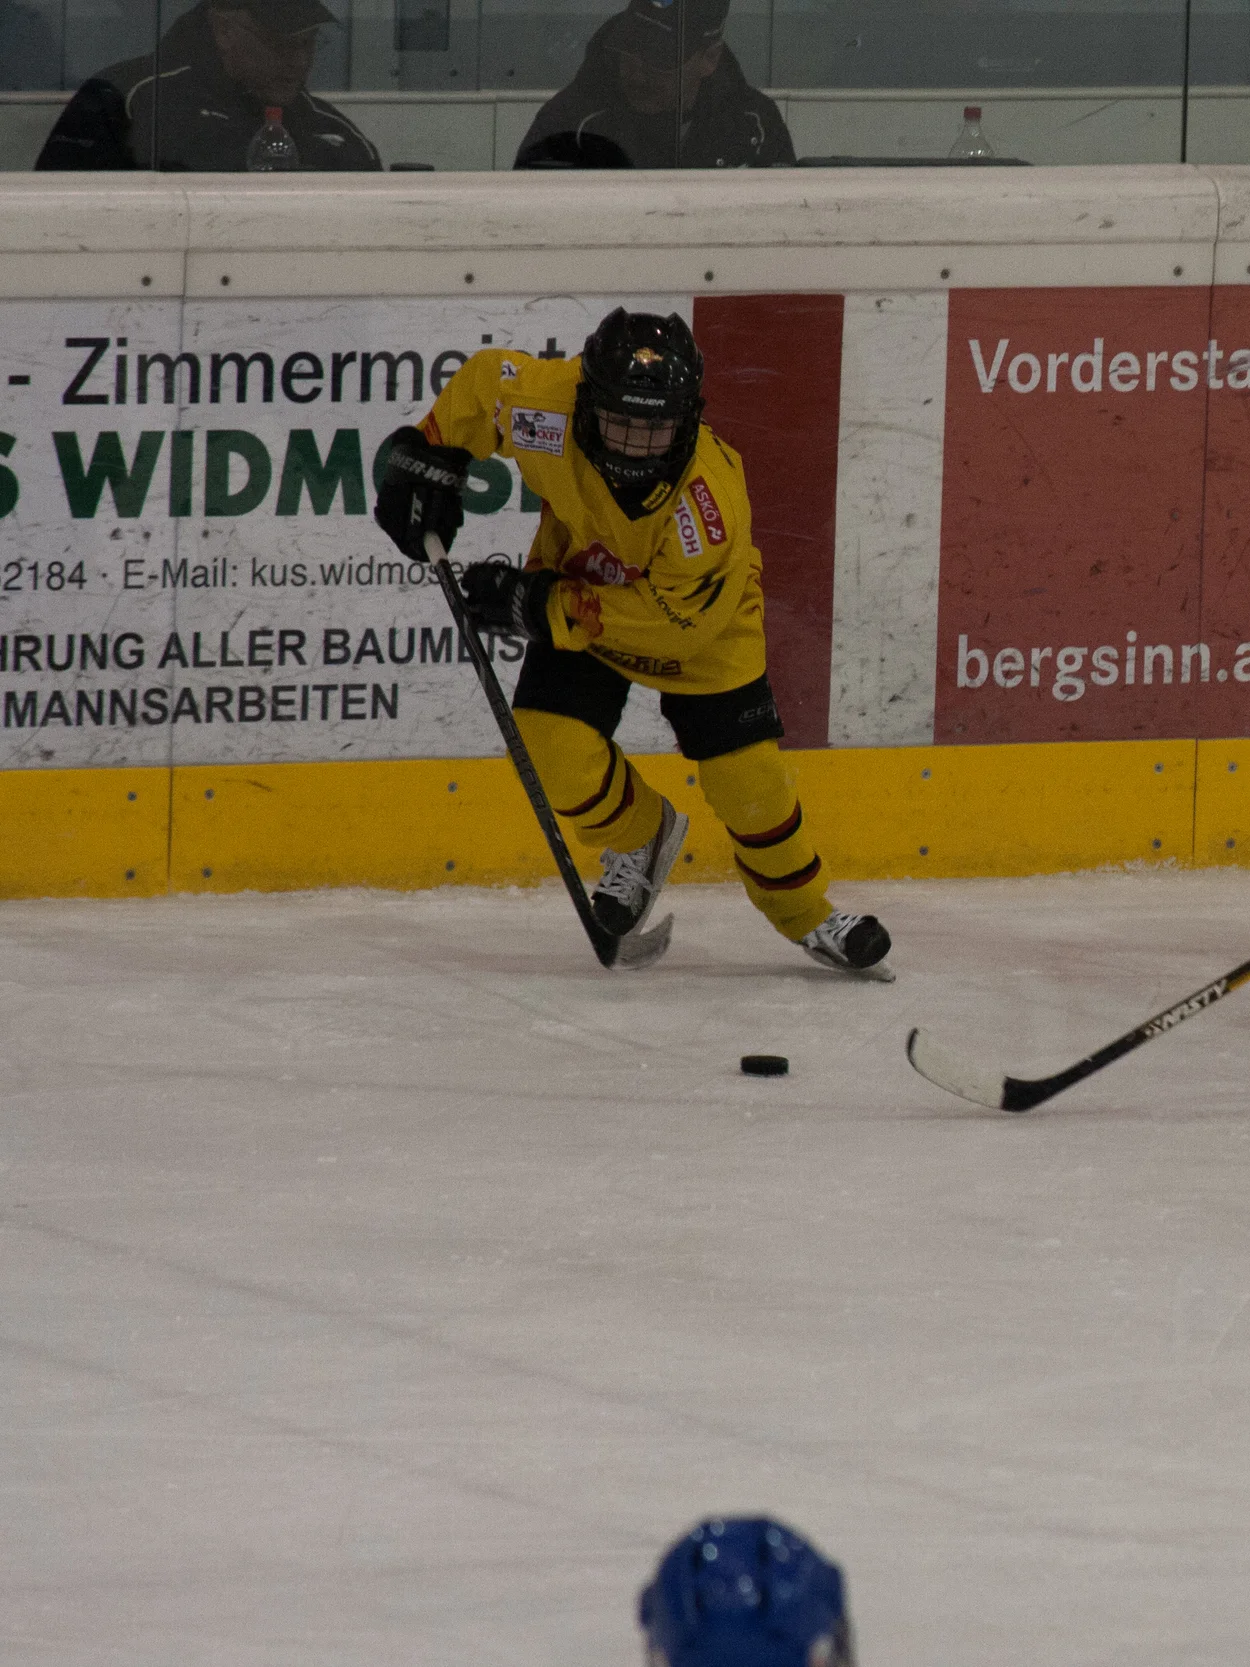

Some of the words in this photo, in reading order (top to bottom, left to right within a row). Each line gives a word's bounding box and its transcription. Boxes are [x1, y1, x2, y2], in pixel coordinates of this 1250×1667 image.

[691, 483, 719, 522] ASKÖ
[675, 504, 700, 554] ICOH
[123, 557, 238, 589] E-Mail:
[157, 629, 307, 669] ALLER
[3, 682, 399, 728] MANNSARBEITEN
